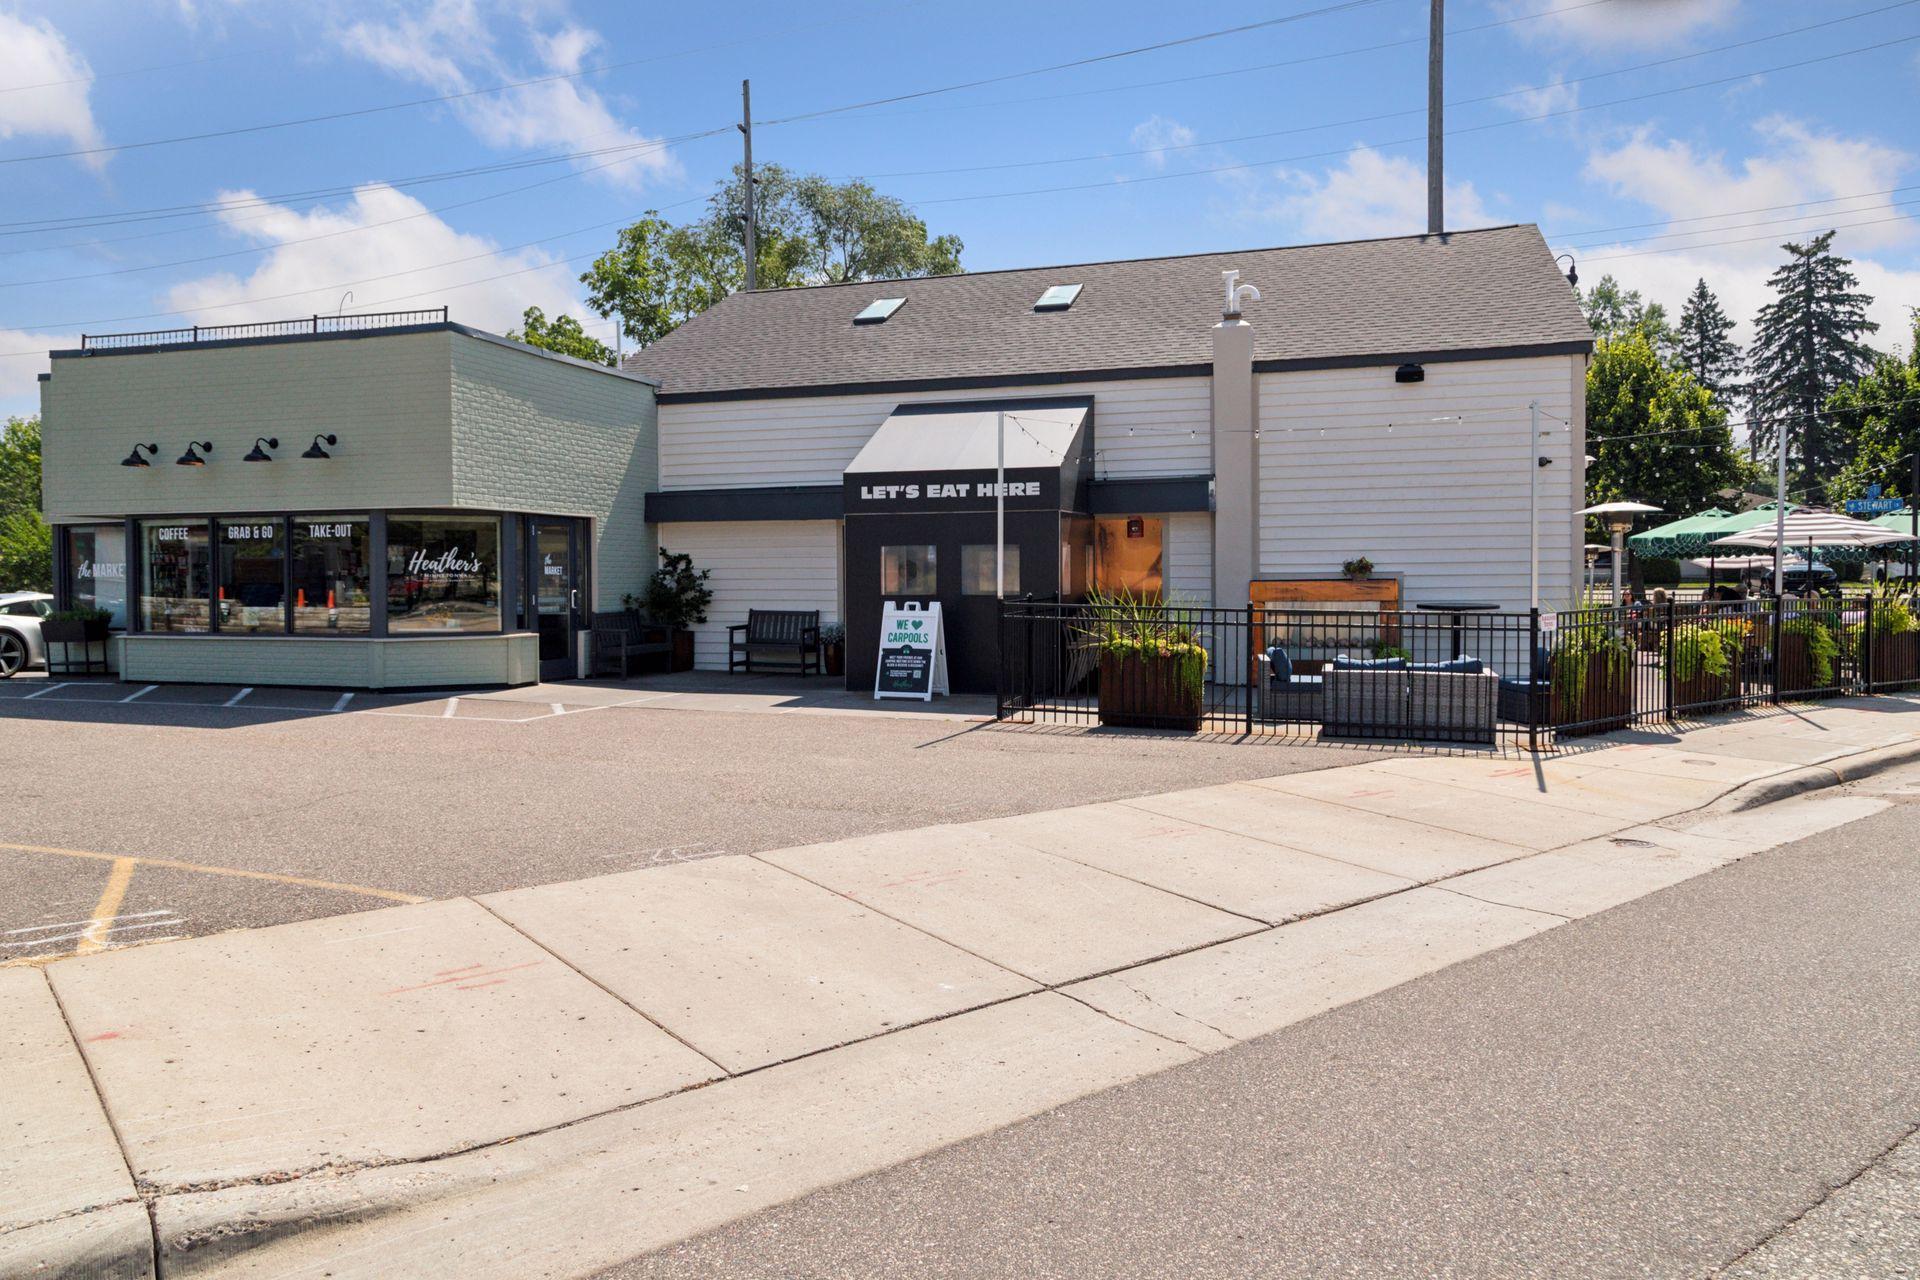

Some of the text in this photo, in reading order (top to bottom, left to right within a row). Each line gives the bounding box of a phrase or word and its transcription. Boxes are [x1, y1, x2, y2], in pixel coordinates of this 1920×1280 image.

[861, 482, 1040, 500] LET'S EAT HERE
[1857, 500, 1893, 511] STEWART
[158, 527, 189, 540] COFFEE
[228, 525, 273, 539] GRAB & GO
[309, 524, 352, 538] TAKE-OUT
[408, 546, 482, 575] Heather's
[77, 560, 91, 579] the
[544, 566, 563, 575] MARKET
[896, 619, 909, 630] WE
[887, 632, 929, 643] CARPOOLS
